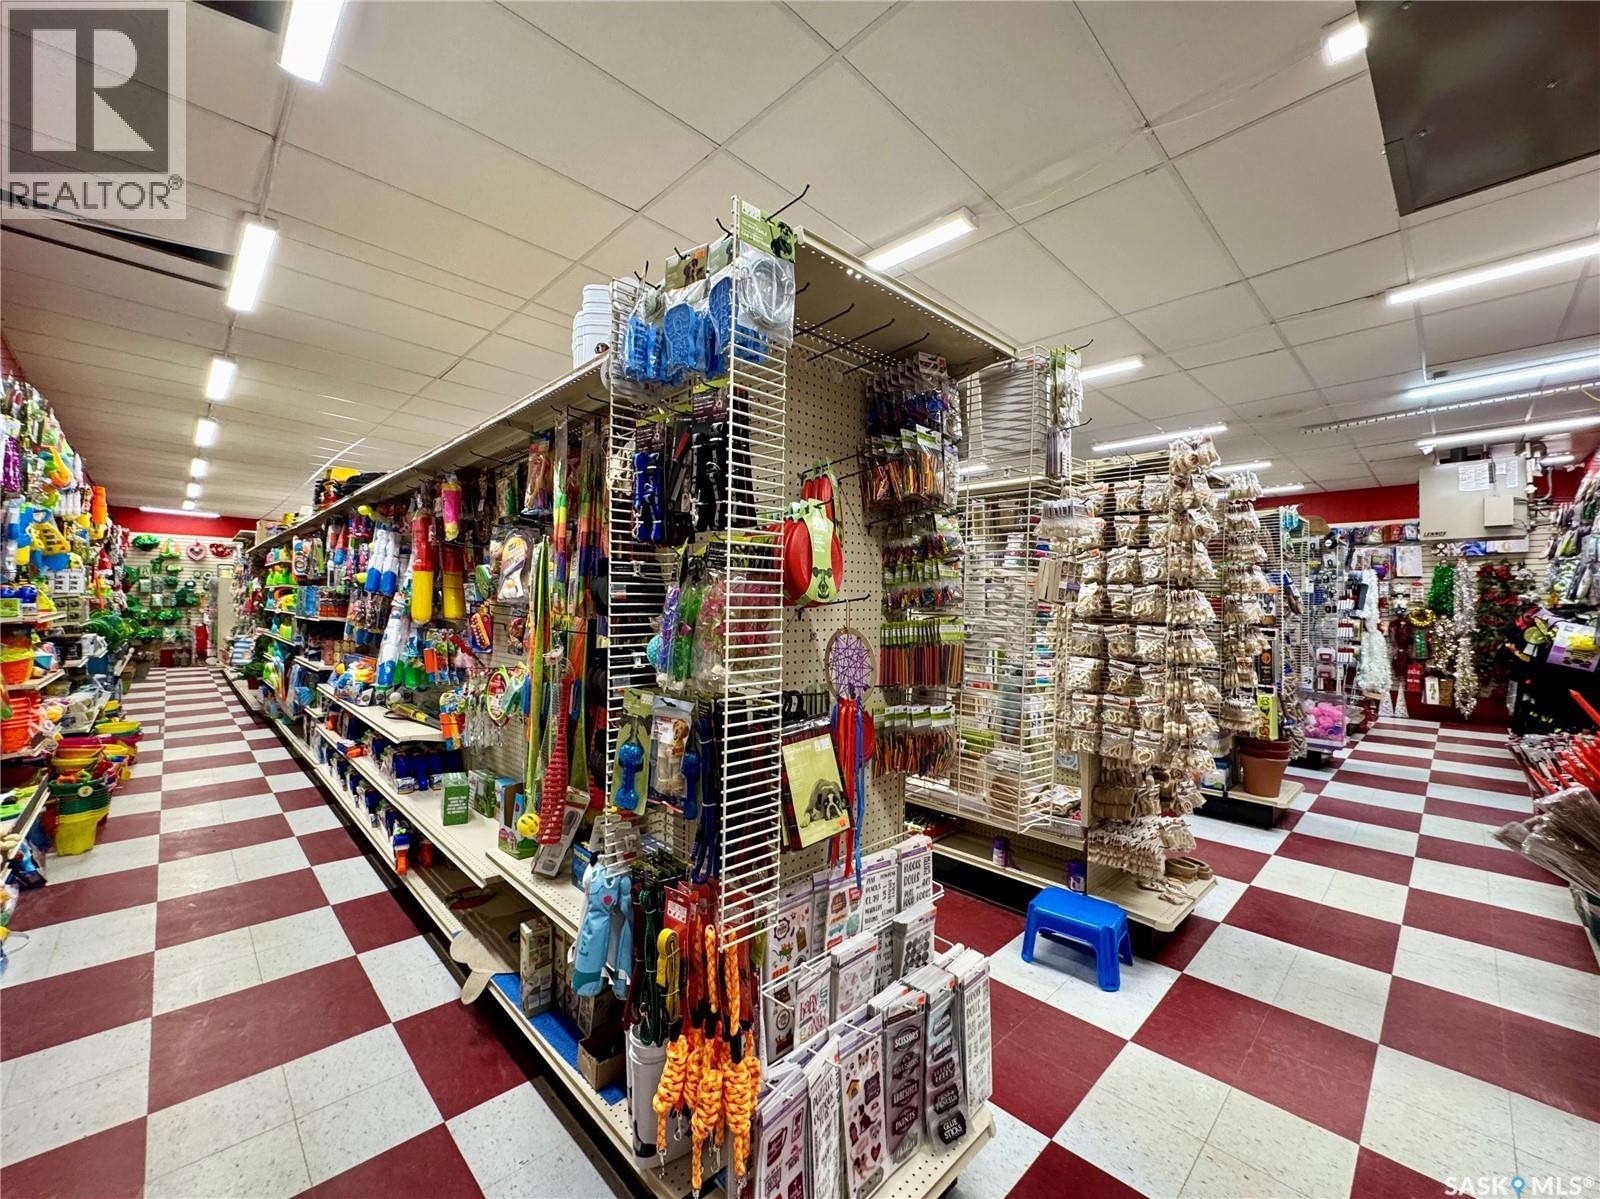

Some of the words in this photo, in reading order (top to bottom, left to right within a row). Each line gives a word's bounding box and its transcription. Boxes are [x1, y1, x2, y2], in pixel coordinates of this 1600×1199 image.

[894, 1029, 919, 1049] SCISSORS
[943, 1117, 958, 1131] GLUE
[944, 1125, 963, 1140] STICKS
